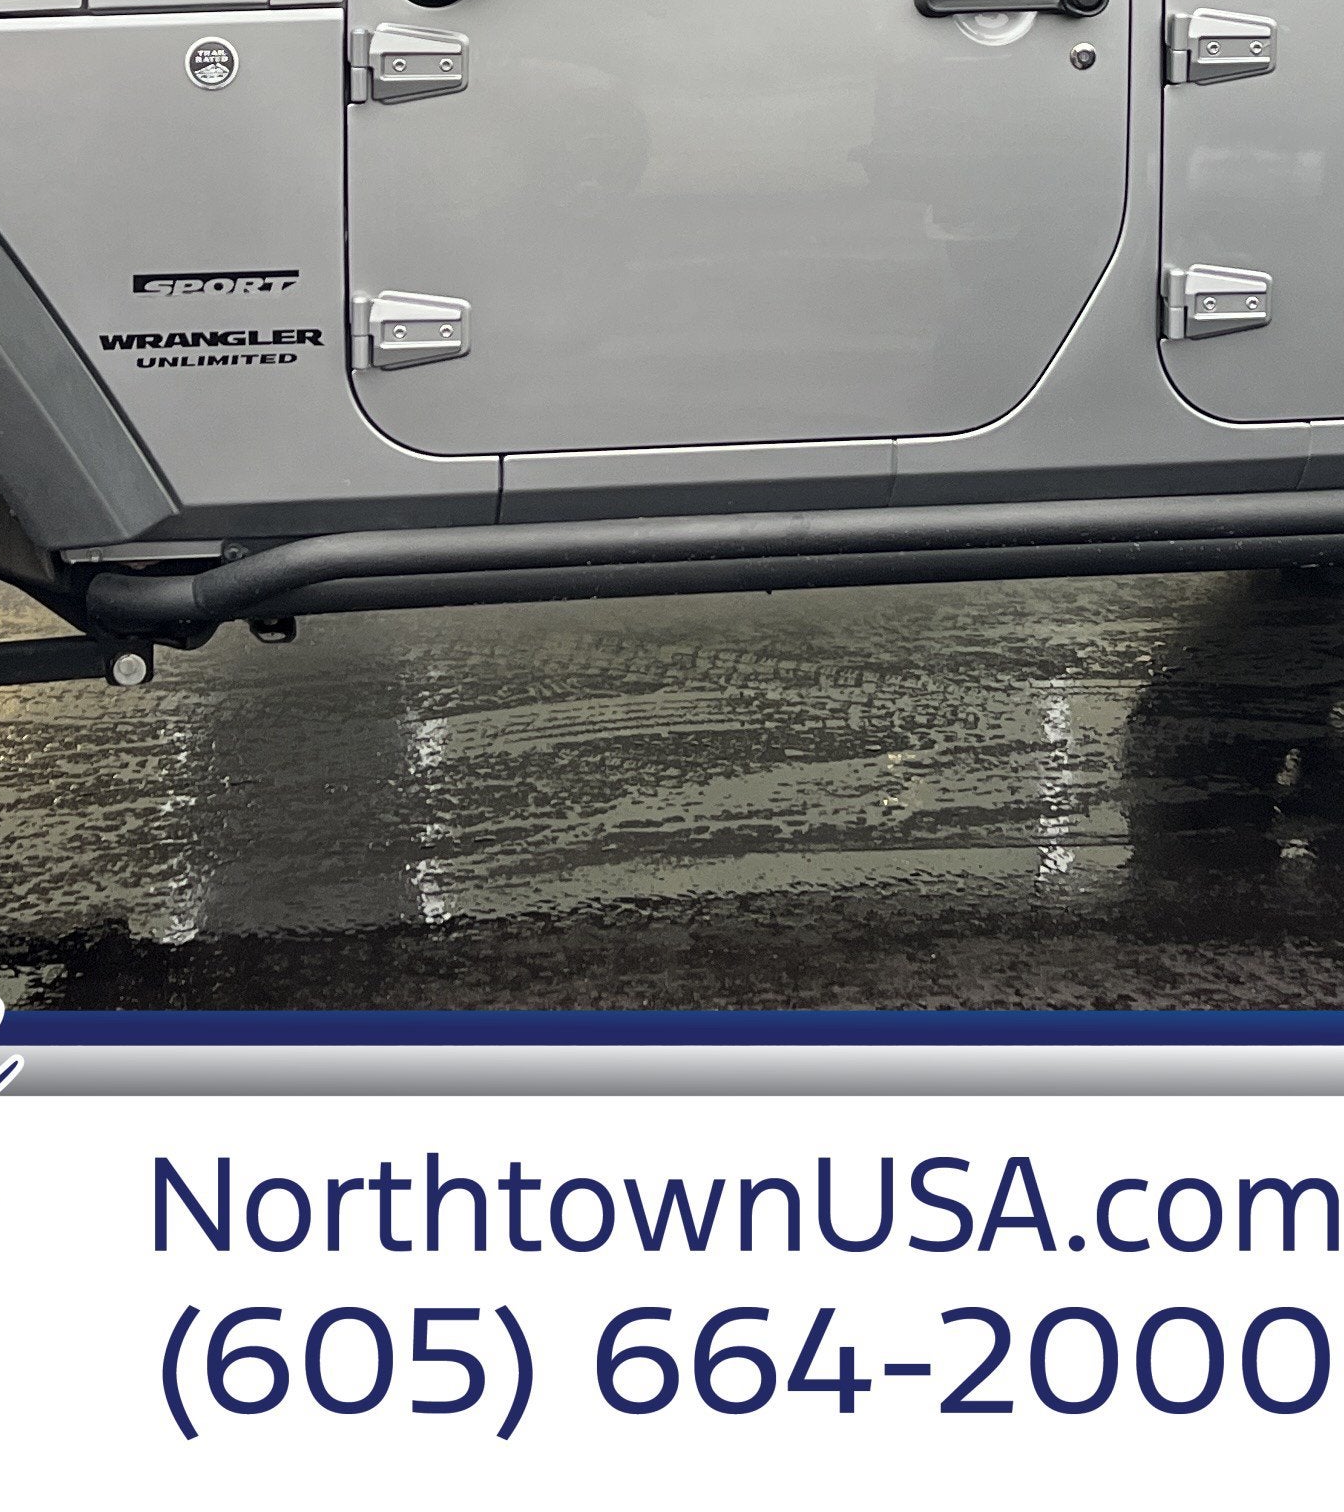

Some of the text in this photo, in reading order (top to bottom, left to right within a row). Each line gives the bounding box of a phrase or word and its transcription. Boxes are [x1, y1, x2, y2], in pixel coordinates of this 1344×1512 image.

[194, 55, 229, 63] RATED
[137, 272, 299, 297] SPORT
[98, 328, 326, 351] WRANGLER
[136, 353, 298, 368] UNLIMITED
